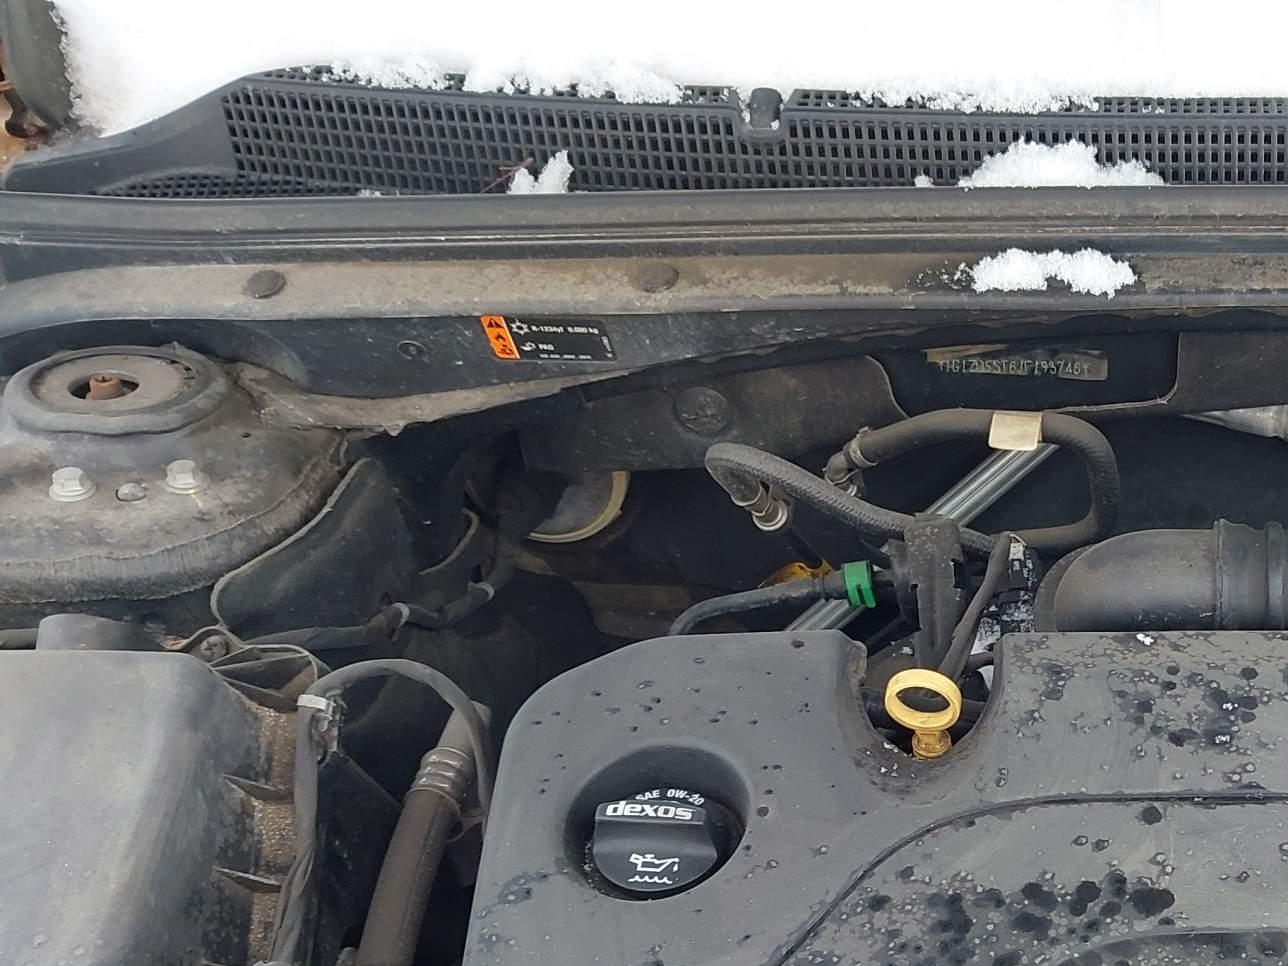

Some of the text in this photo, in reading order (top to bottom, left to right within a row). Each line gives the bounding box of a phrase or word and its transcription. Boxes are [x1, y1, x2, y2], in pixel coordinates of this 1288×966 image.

[635, 788, 705, 806] SAE 0W-20
[605, 800, 693, 821] dexos
